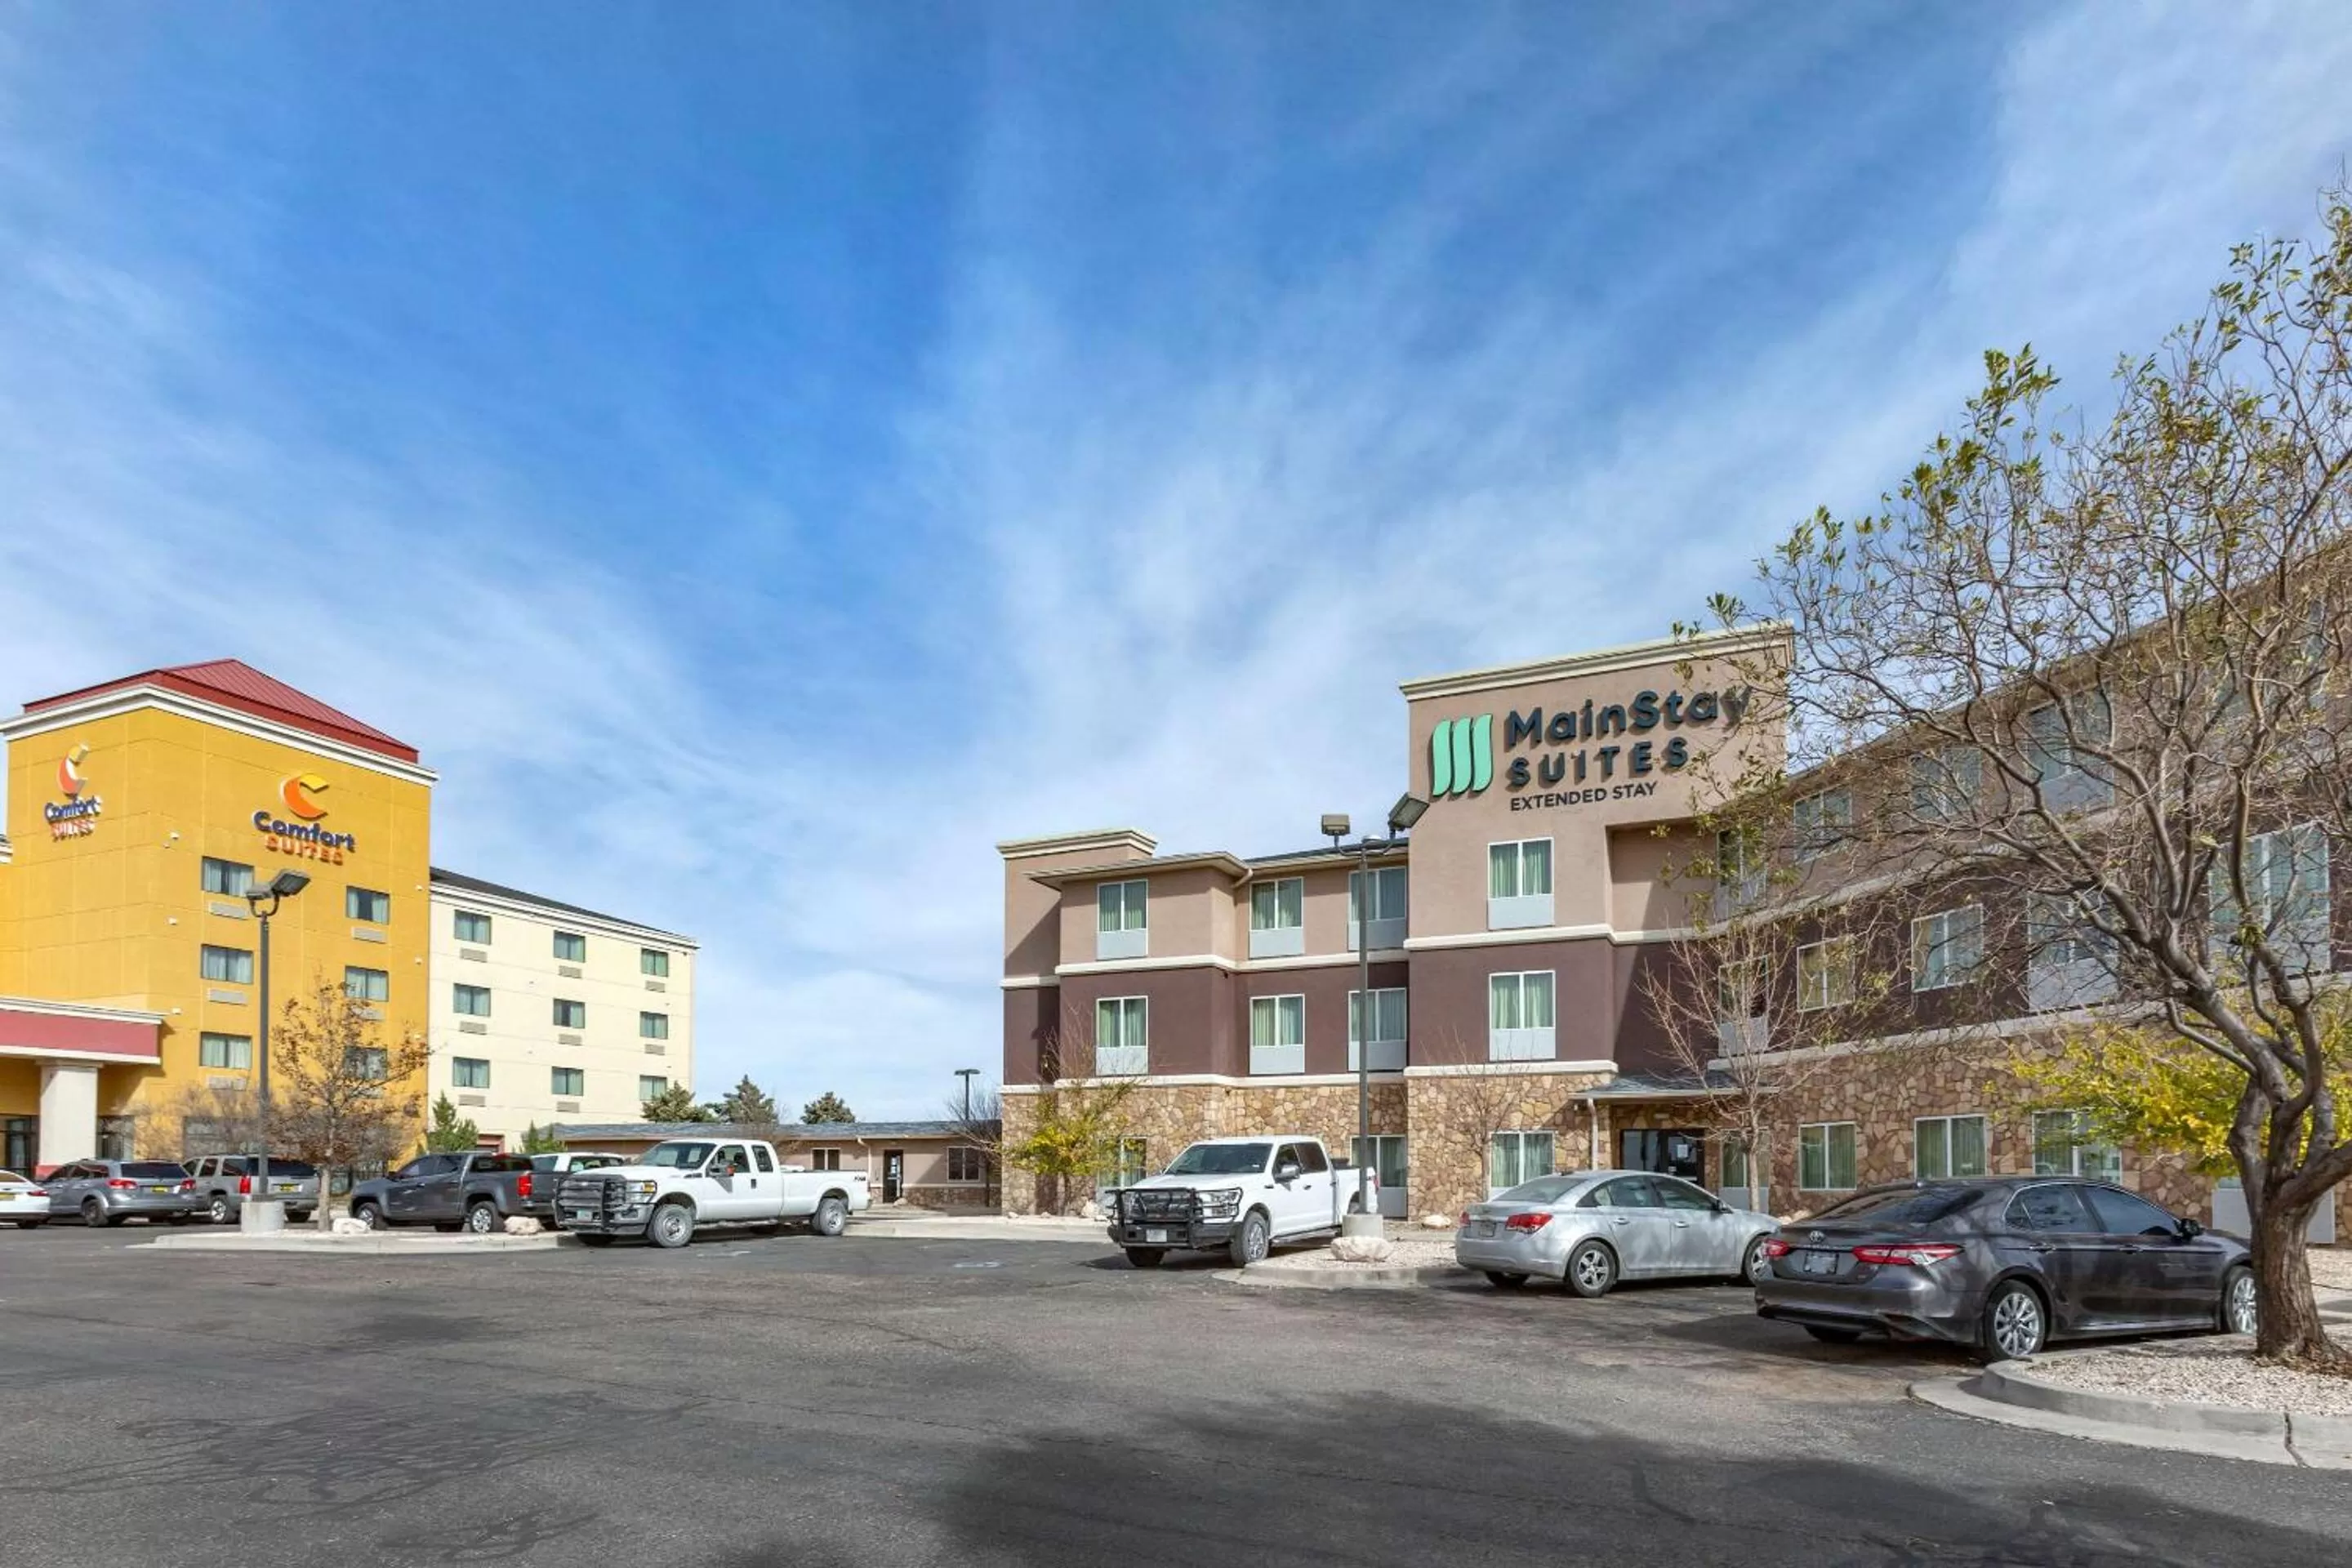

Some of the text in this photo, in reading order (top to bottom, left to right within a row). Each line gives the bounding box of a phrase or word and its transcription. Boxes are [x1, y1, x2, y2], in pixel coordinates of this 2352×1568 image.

[1509, 737, 1688, 787] SUITES
[45, 796, 101, 822] Comfort
[1510, 781, 1659, 811] EXTENDED STAY
[252, 810, 355, 853] Comfort
[265, 834, 343, 866] SUITES
